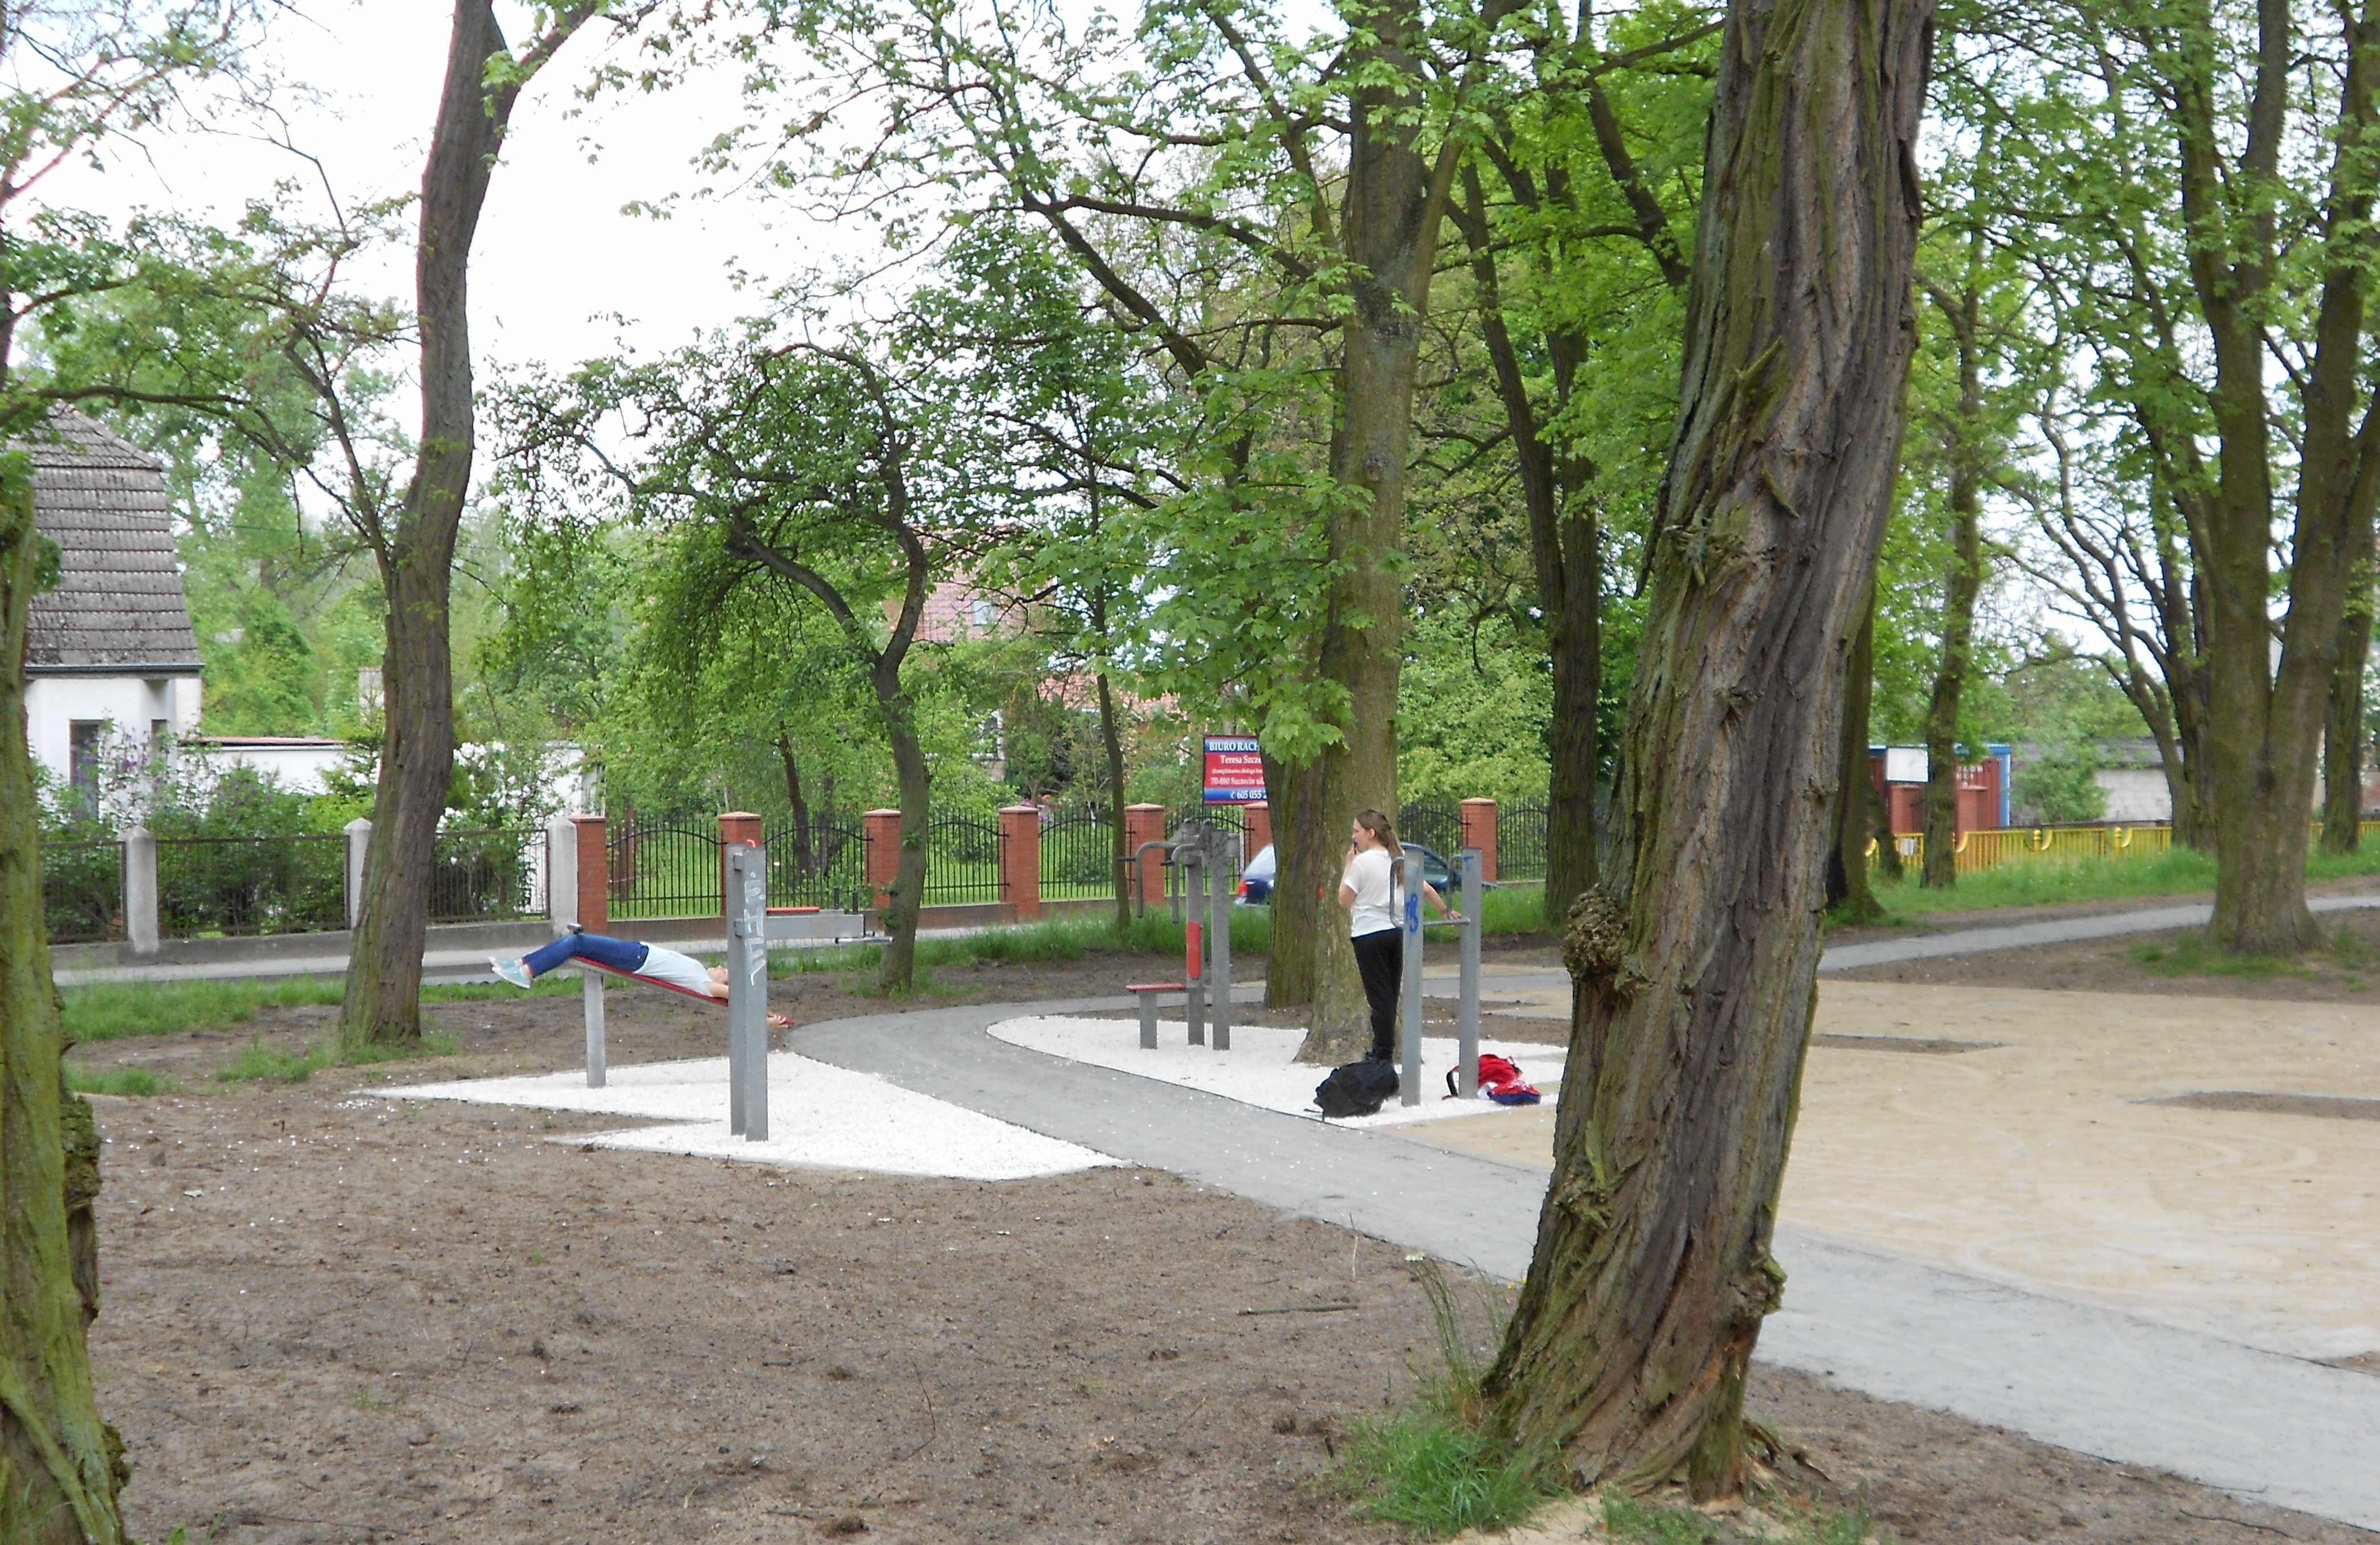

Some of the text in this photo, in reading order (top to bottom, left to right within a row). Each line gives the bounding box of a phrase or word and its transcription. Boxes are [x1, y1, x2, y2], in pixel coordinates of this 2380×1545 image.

[1209, 742, 1236, 751] BIURO
[1220, 754, 1242, 764] Teresa
[1230, 776, 1255, 785] Szczecin
[1237, 790, 1249, 799] 605
[1249, 790, 1262, 799] 055
